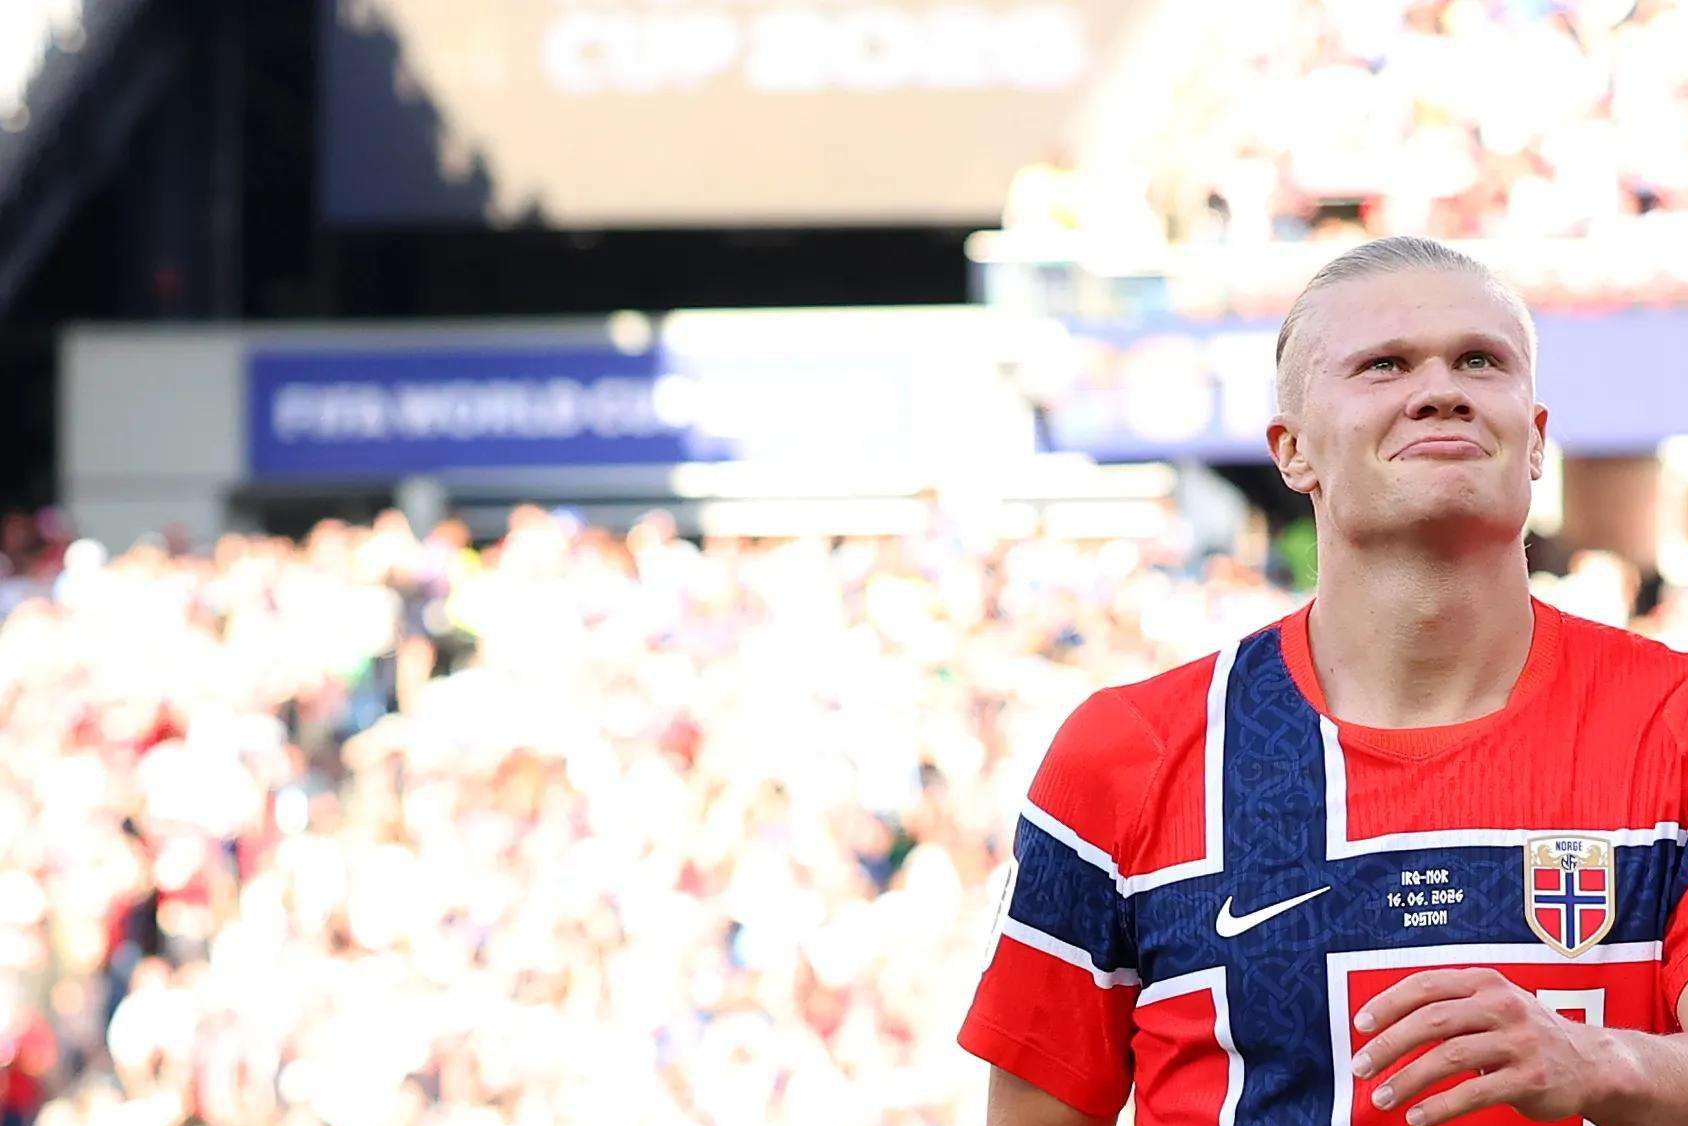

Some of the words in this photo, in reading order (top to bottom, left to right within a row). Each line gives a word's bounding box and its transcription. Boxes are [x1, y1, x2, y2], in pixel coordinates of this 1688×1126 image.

[1555, 841, 1582, 852] NORGE
[1401, 869, 1448, 886] IRQ-NOR
[1403, 910, 1447, 927] BOSTON
